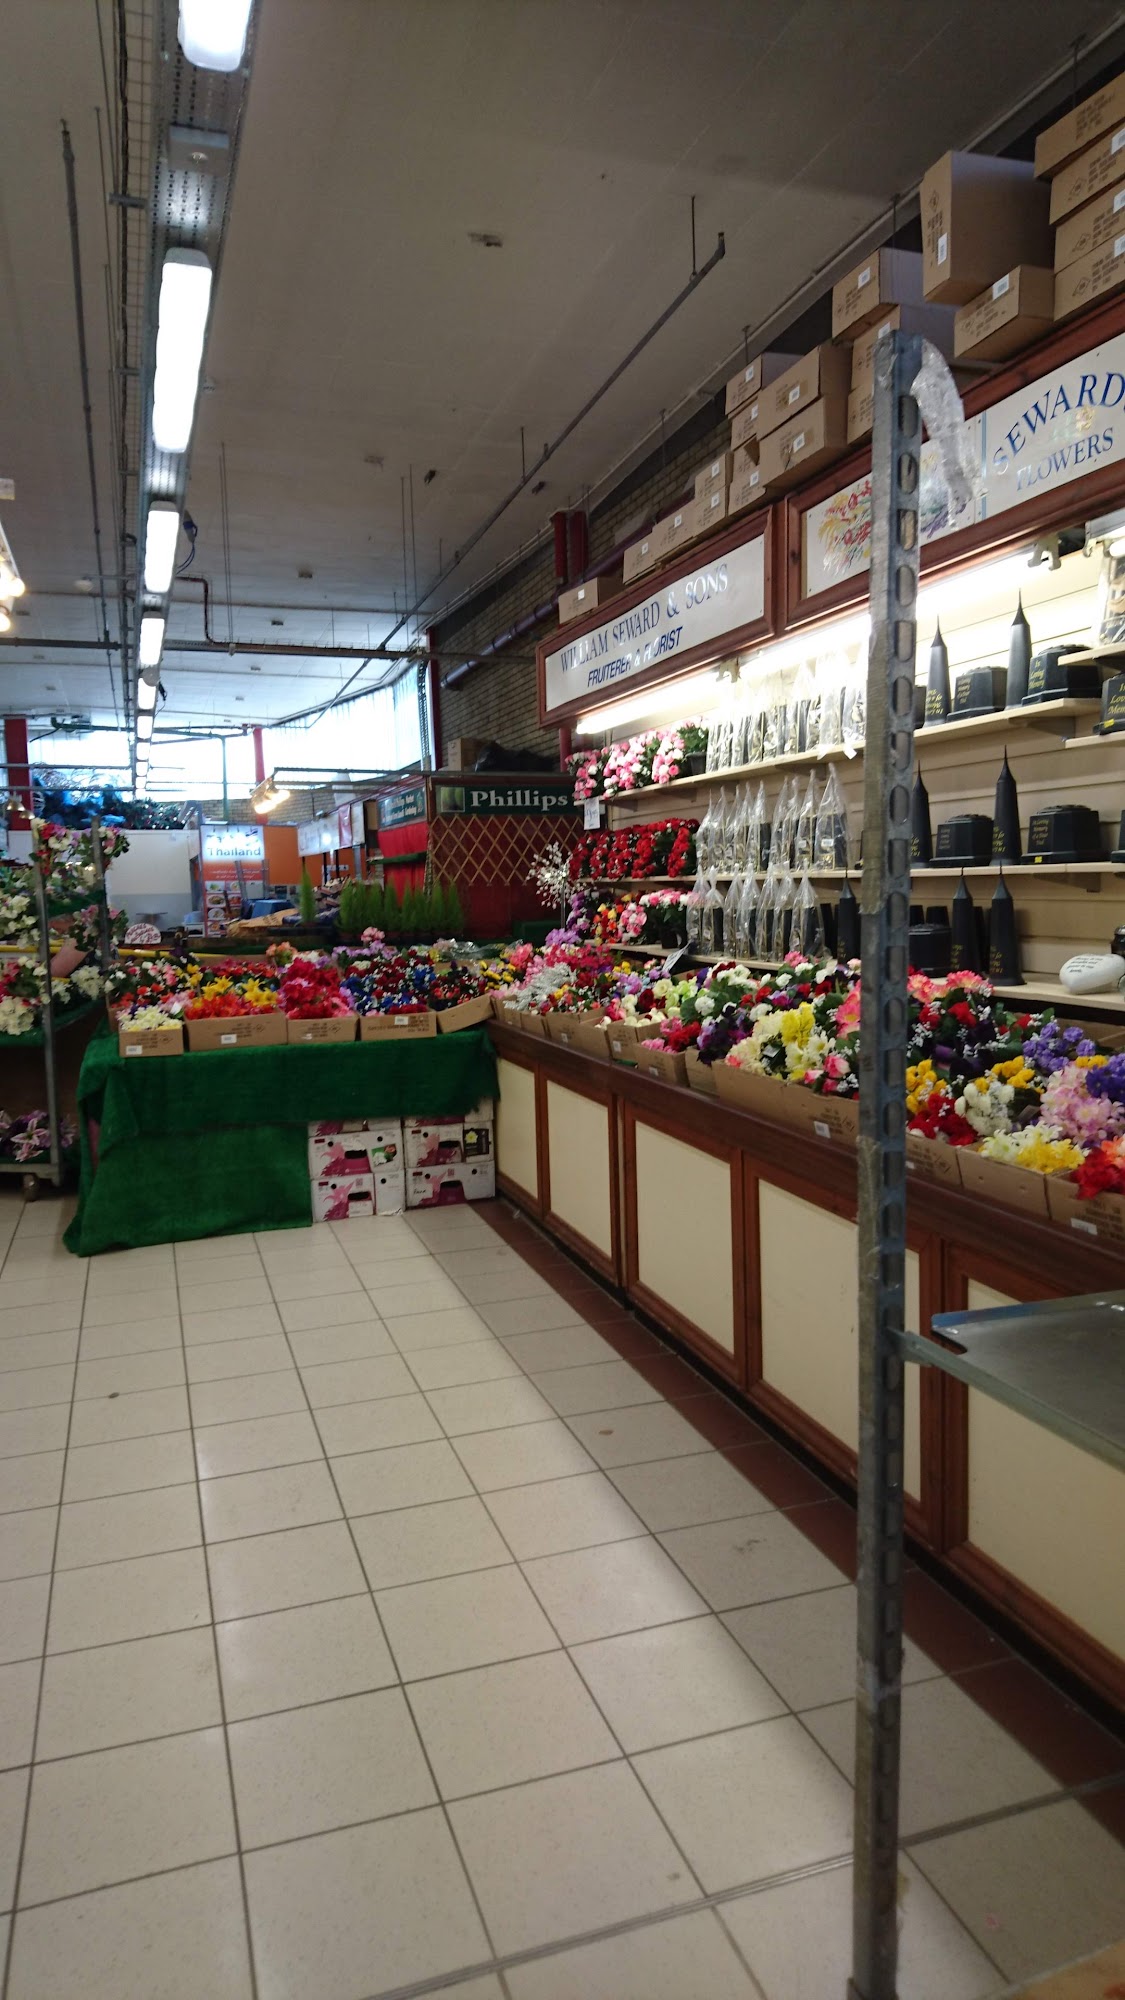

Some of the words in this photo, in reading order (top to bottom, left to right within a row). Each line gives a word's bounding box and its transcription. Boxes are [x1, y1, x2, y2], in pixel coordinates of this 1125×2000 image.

[992, 371, 1125, 476] SEWARD
[1016, 426, 1114, 491] FLOWERS
[560, 629, 609, 674] WILLIAM
[612, 601, 661, 648] SEWARD
[666, 591, 680, 618] &
[685, 563, 728, 609] SONS
[587, 653, 632, 688] FRUITERER
[633, 650, 641, 666] &
[643, 625, 684, 662] FLORIST
[470, 789, 568, 811] Phillips
[207, 847, 261, 856] Thailand
